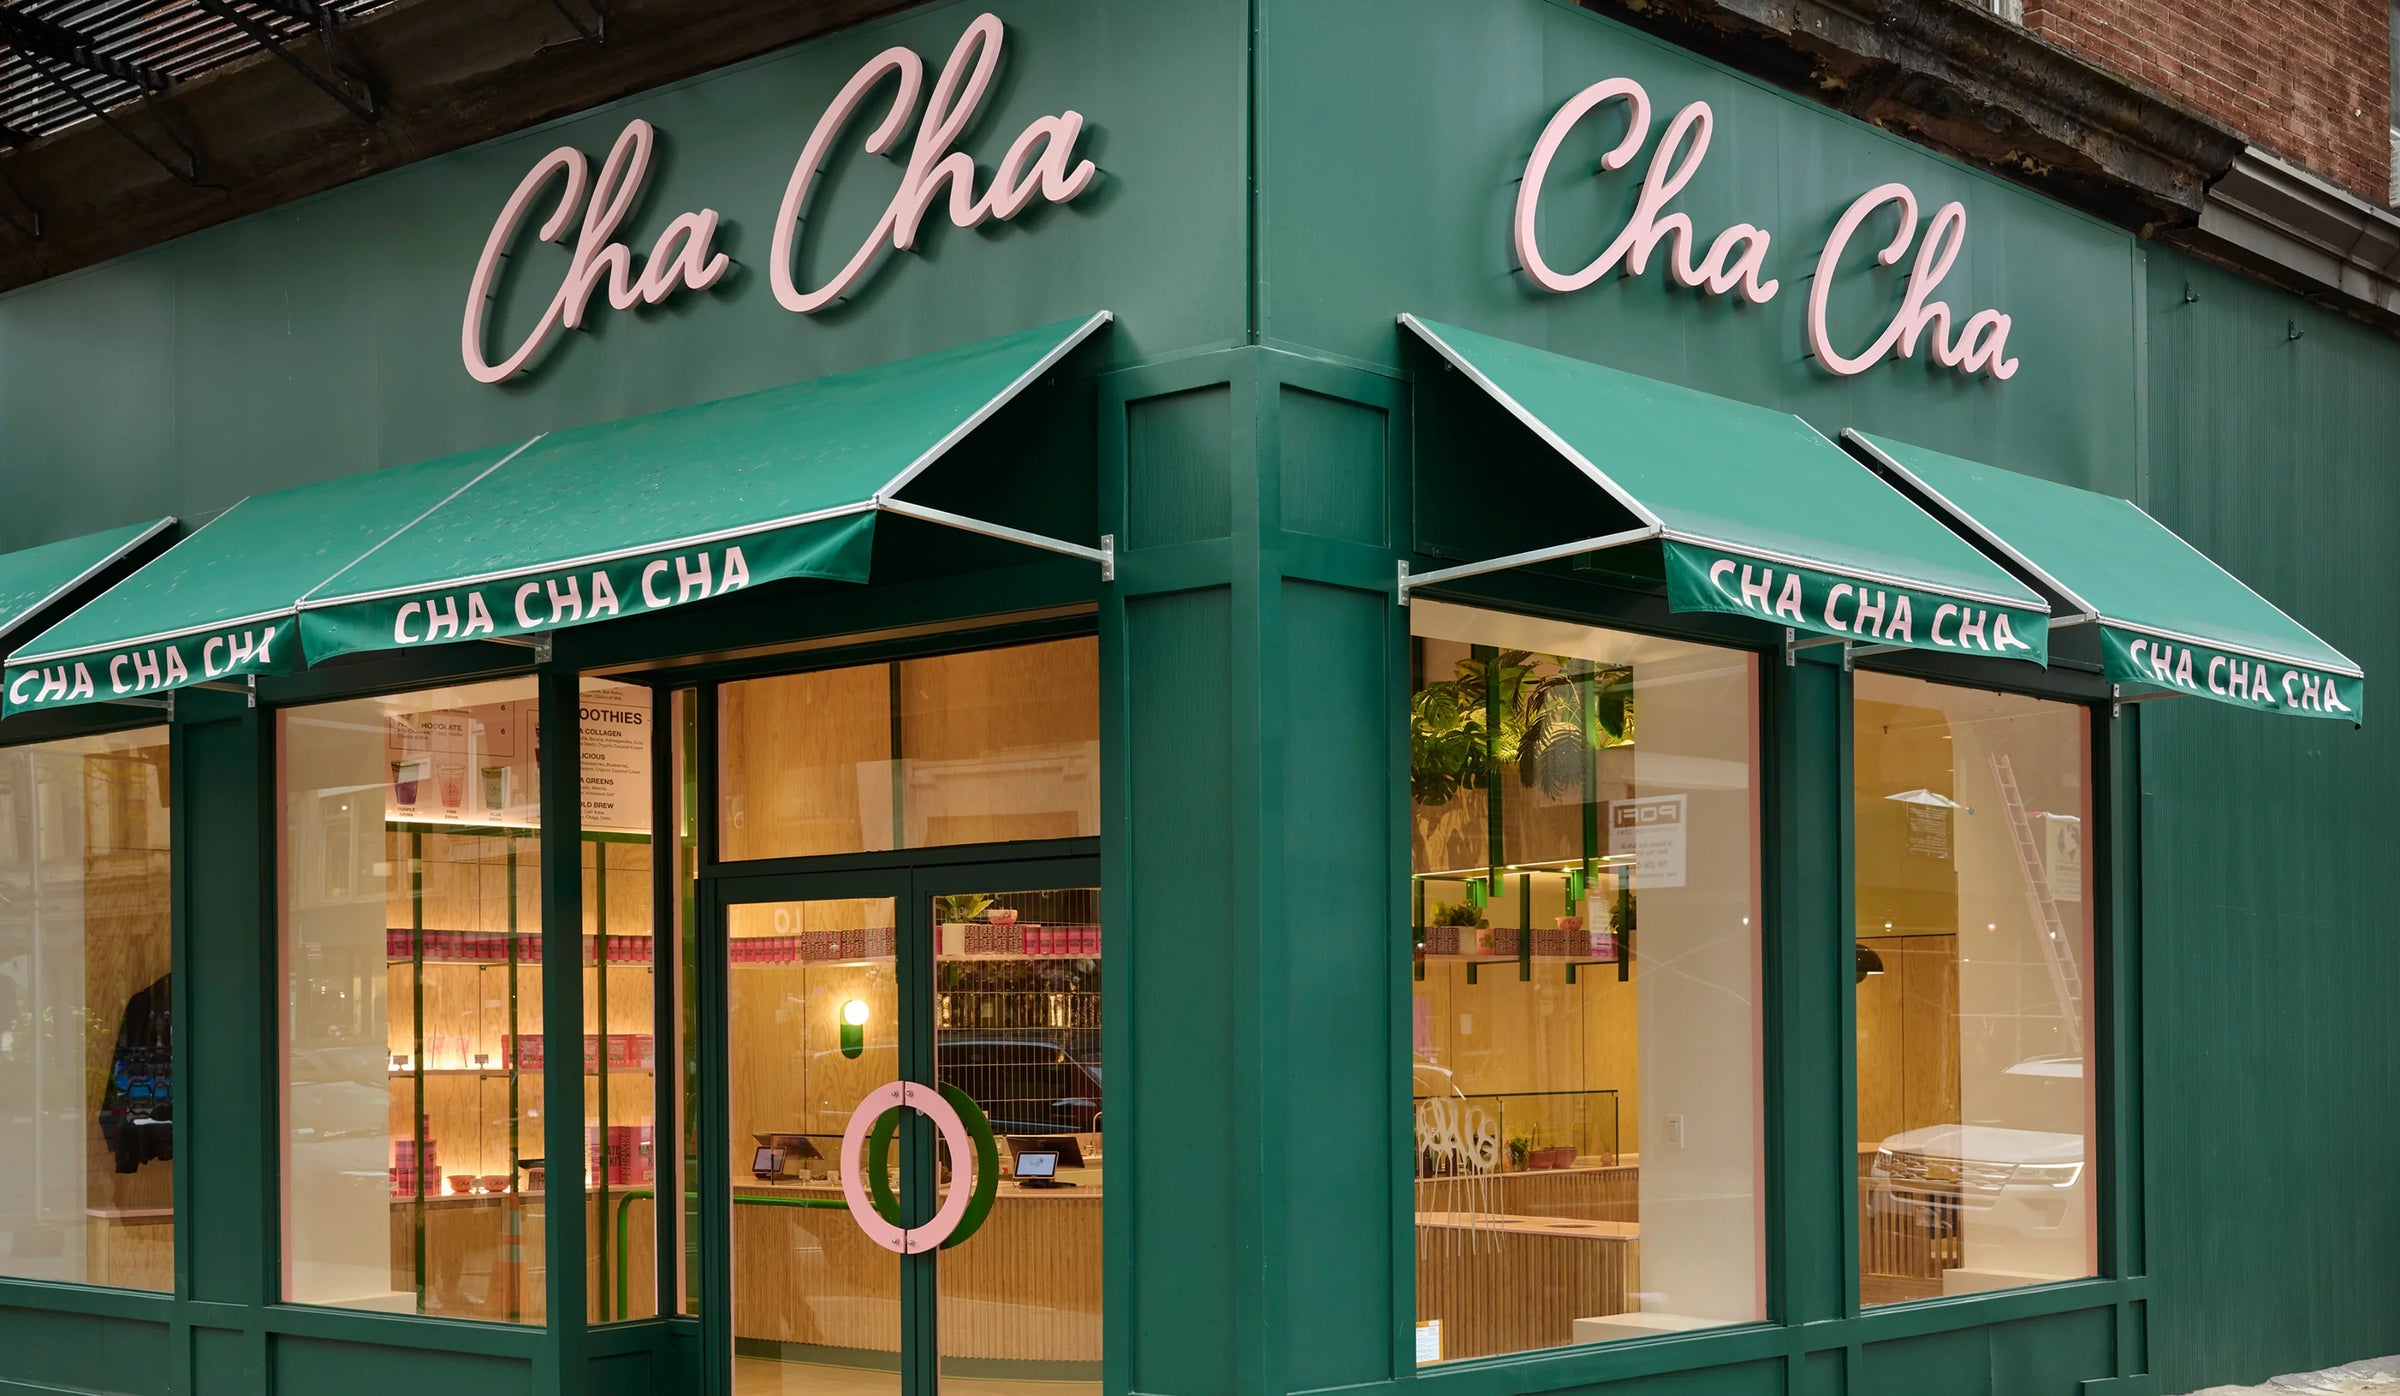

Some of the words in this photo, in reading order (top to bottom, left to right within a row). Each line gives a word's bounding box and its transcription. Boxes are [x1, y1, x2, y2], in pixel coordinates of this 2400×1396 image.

[463, 119, 729, 383] Cha
[770, 13, 1094, 313] Cha
[1515, 77, 1779, 304] Cha
[1809, 183, 2019, 380] Cha
[394, 591, 495, 645] CHA
[514, 570, 619, 629] CHA
[641, 546, 751, 608] CHA
[1709, 559, 1806, 623] CHA
[1823, 583, 1913, 643] CHA
[1931, 603, 2032, 651] CHA
[9, 662, 95, 705] CHA
[109, 645, 189, 694] CHA
[203, 626, 276, 678] CHA
[2130, 639, 2198, 690] CHA
[2208, 656, 2276, 703] CHA
[2282, 670, 2352, 713] CHA
[580, 707, 643, 725] OOTHIES
